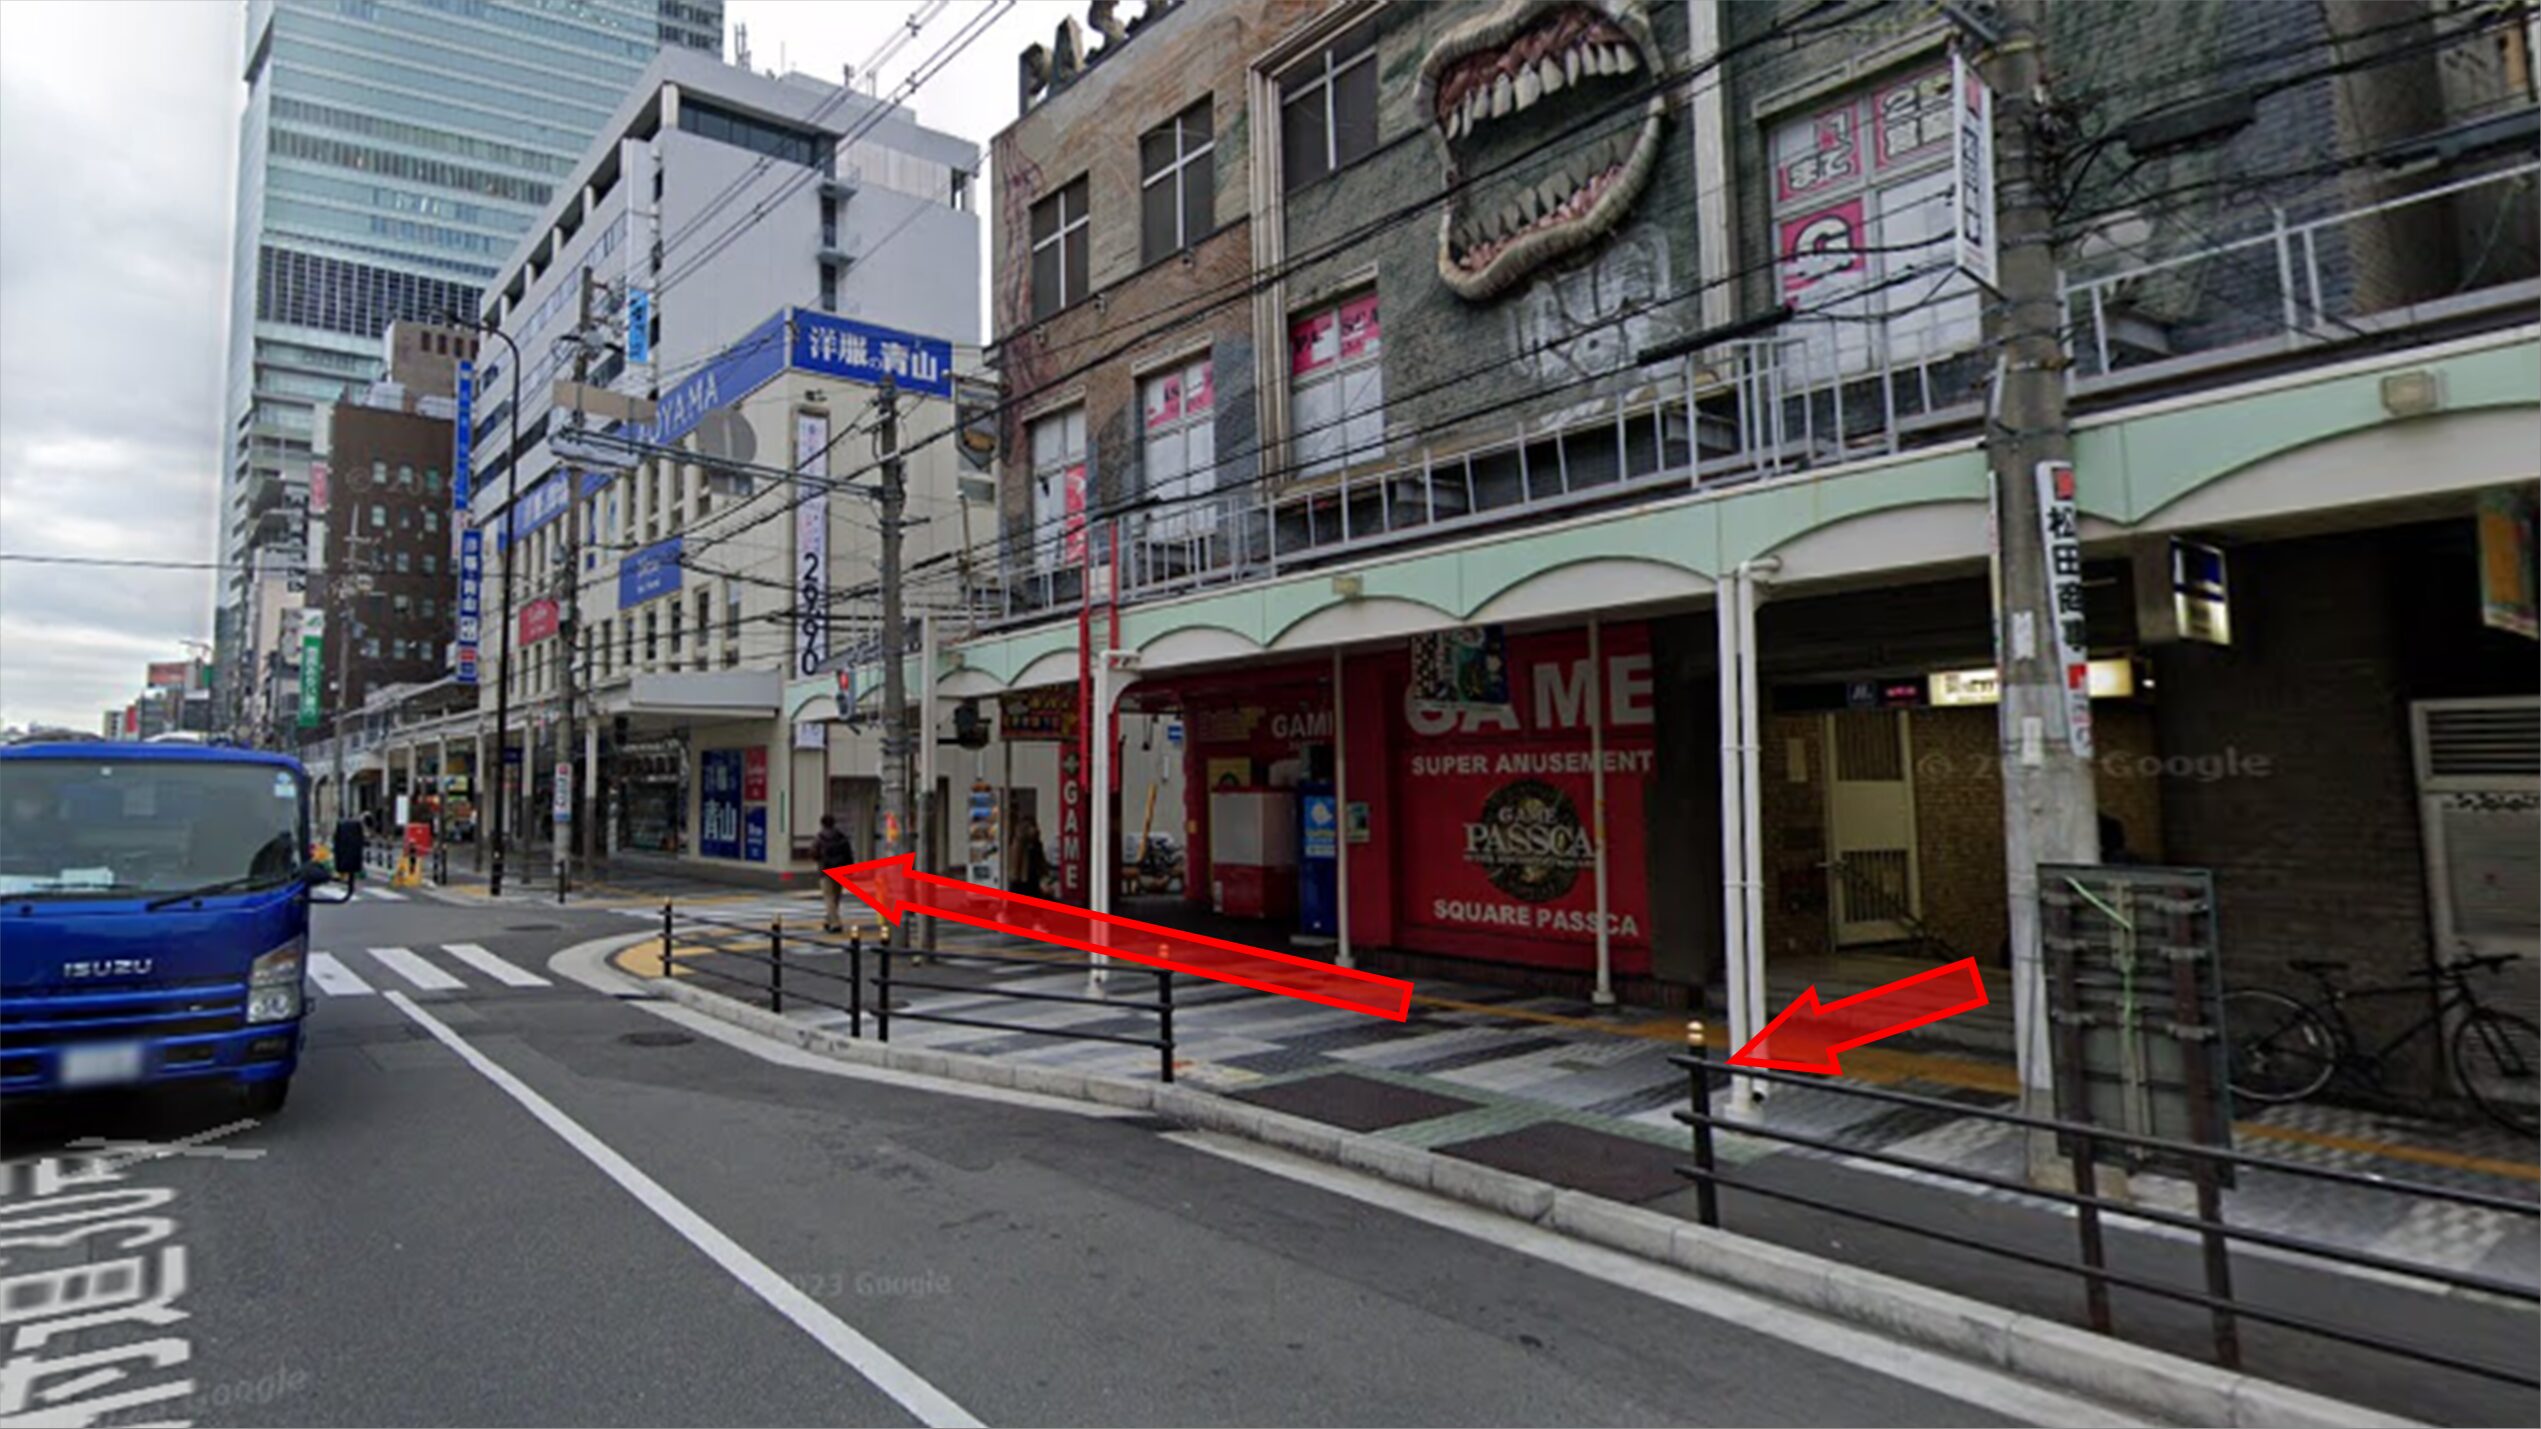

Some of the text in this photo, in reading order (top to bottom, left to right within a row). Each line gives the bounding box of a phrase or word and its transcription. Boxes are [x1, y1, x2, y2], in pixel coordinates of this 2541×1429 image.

[809, 326, 938, 383] 洋服の青山
[801, 551, 820, 677] 2990
[1271, 711, 1333, 738] GAM
[1411, 755, 1488, 775] SUPER
[703, 799, 737, 842] 青山
[1499, 805, 1557, 823] GAME
[1064, 780, 1080, 888] GAME
[1463, 823, 1595, 858] PASSCA
[1434, 899, 1638, 936] SQUARE PASSCA
[63, 959, 152, 978] ISUZU
